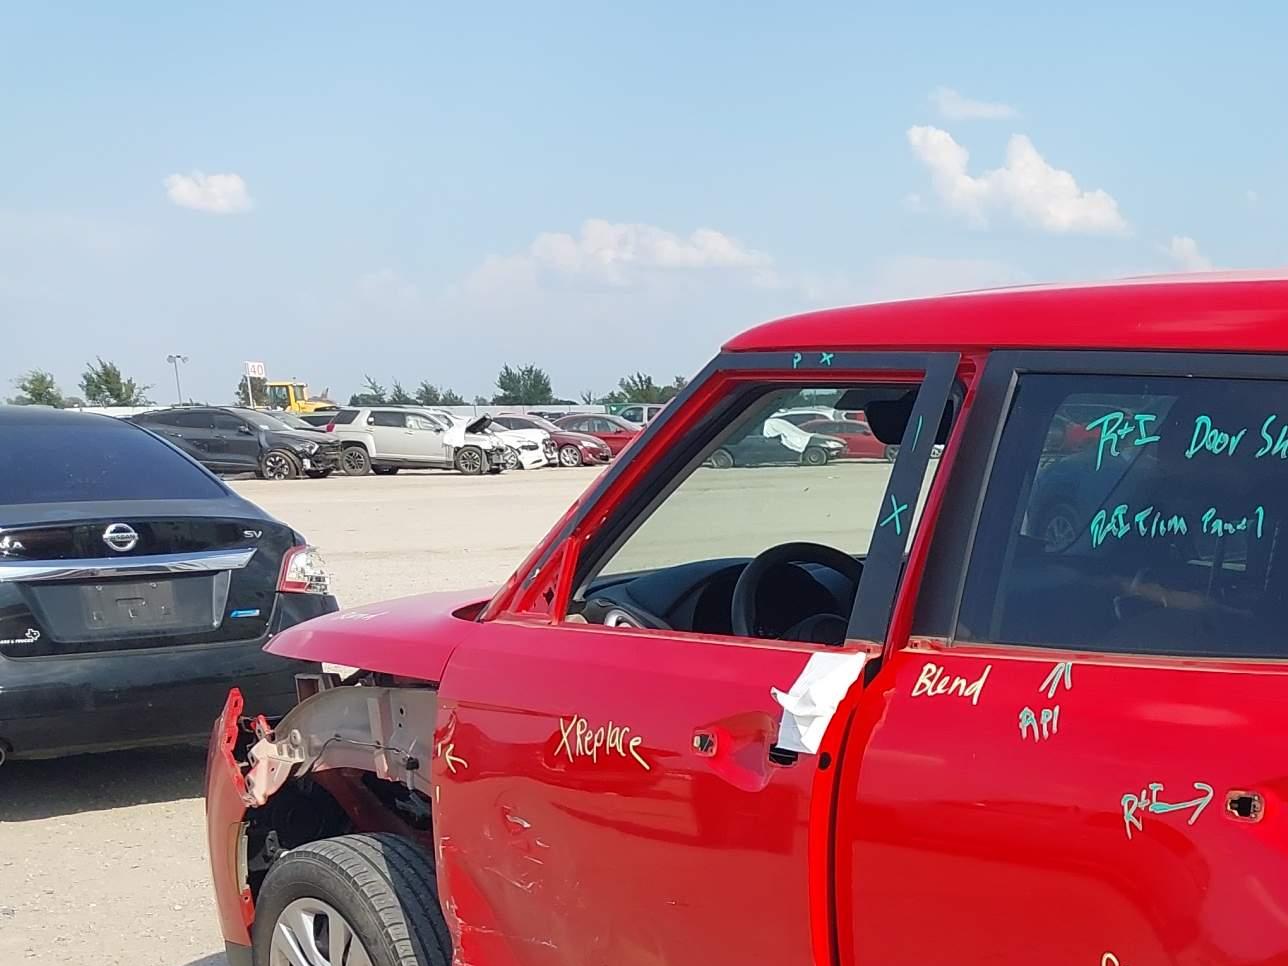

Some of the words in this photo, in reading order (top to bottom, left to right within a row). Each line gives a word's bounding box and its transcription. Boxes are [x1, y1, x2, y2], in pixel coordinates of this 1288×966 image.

[1185, 415, 1248, 459] Door
[243, 530, 263, 538] SV
[911, 662, 993, 705] Blend
